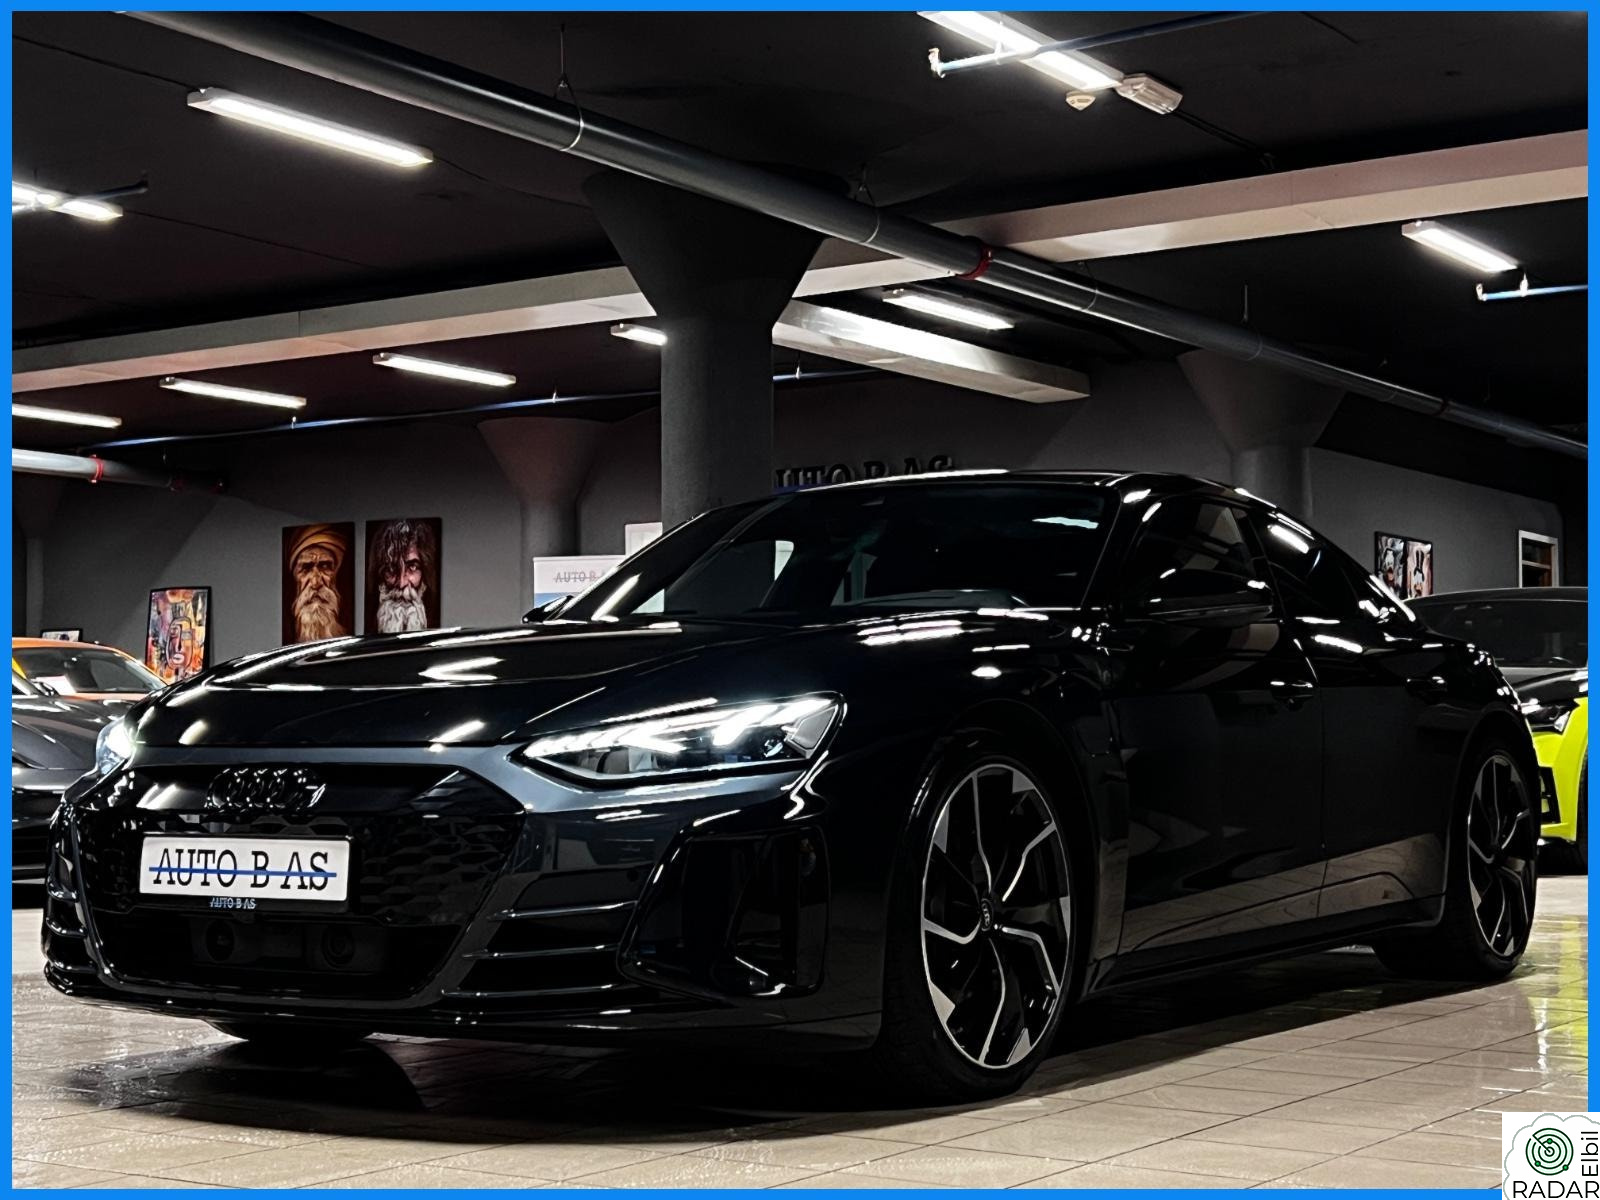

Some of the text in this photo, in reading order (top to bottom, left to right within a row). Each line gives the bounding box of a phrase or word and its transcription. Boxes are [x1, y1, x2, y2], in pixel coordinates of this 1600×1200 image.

[775, 464, 852, 488] UTO
[554, 571, 586, 583] AUTO
[153, 848, 328, 891] AUTO B AS
[210, 897, 256, 910] AUTO B AS
